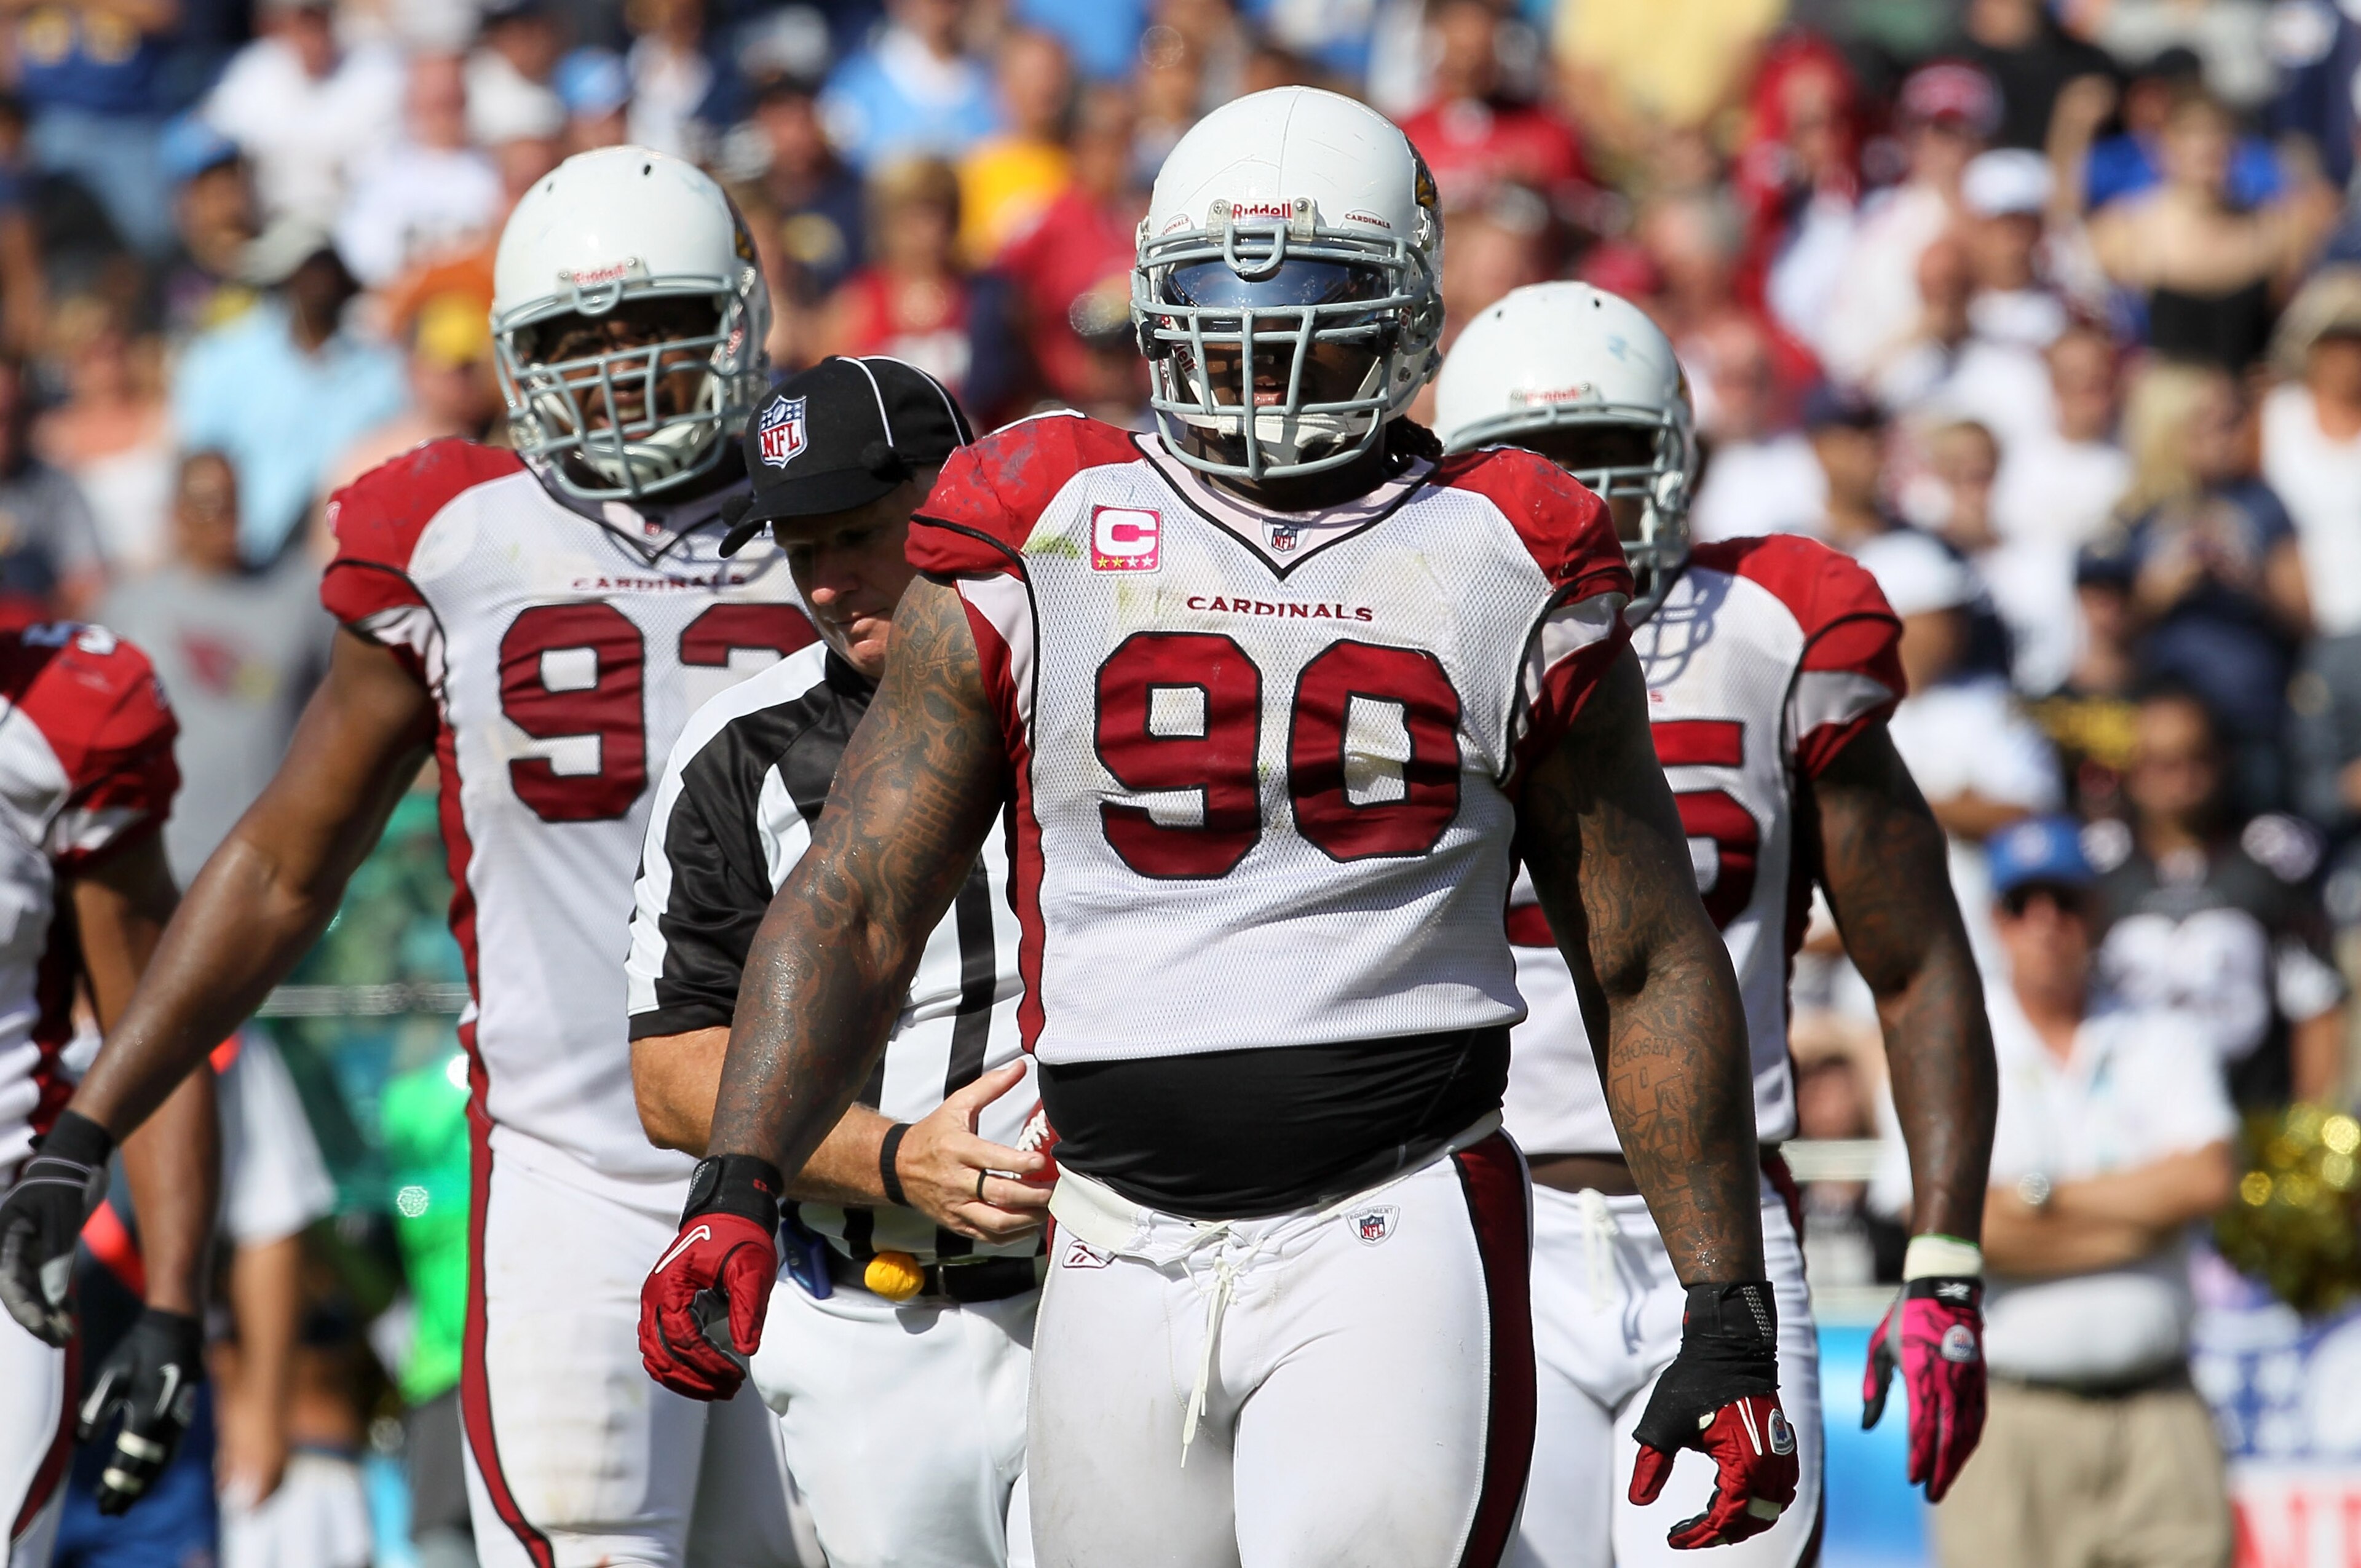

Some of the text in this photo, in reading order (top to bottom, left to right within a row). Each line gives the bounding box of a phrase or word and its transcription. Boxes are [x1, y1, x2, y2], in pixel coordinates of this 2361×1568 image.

[1231, 200, 1292, 220] Riddell
[1345, 213, 1391, 229] CARDINALS
[1162, 216, 1190, 236] ARDINALS
[760, 422, 801, 457] NFL
[1095, 510, 1157, 556] C
[1274, 536, 1295, 549] NFL
[1187, 596, 1374, 622] CARDINALS
[499, 602, 823, 822] 9
[1094, 630, 1462, 880] 90
[1612, 1036, 1674, 1068] CHOSEN
[1349, 1207, 1393, 1220] EQUIPMENT
[1363, 1224, 1384, 1238] NFL
